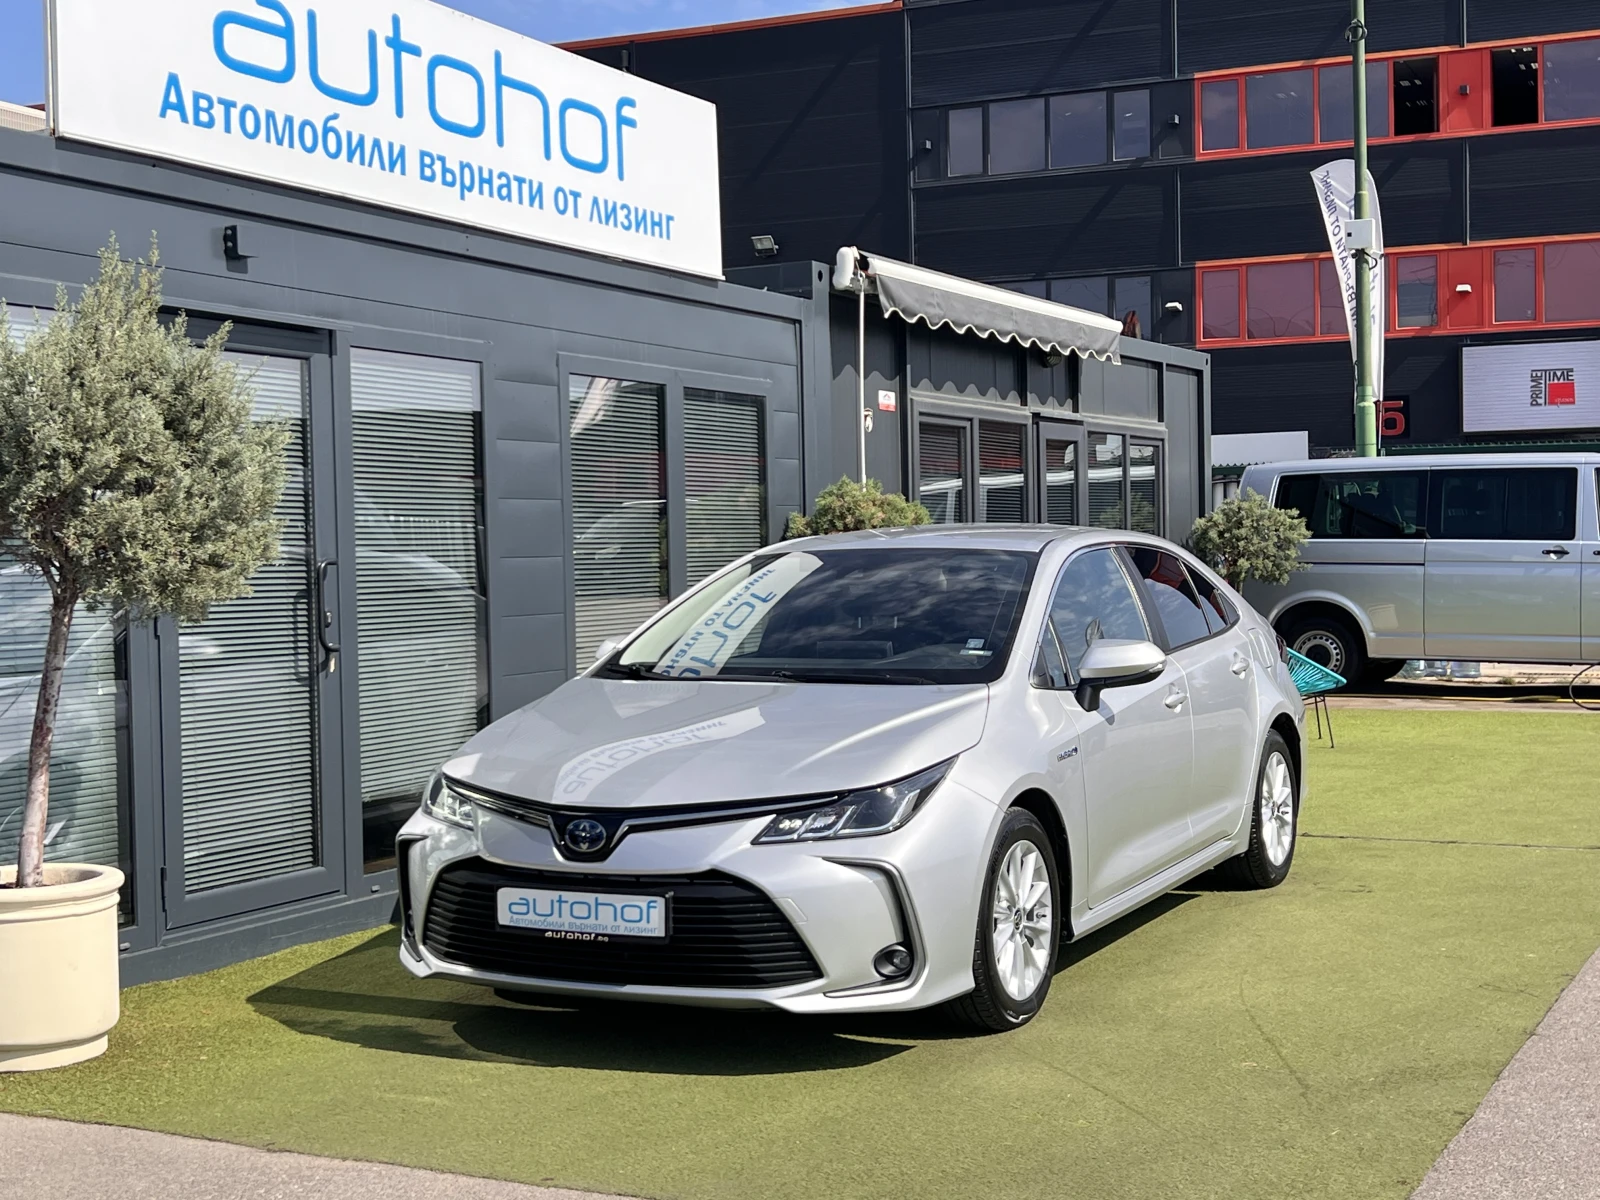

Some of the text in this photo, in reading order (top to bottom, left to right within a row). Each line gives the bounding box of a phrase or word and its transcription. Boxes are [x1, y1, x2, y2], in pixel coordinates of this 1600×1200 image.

[213, 0, 637, 181] autohof
[159, 71, 675, 240] Автомобили върнати от лизинг
[1530, 371, 1543, 406] PRIME
[508, 894, 658, 924] autohof
[509, 915, 658, 934] Автомобили върнати от лизинг
